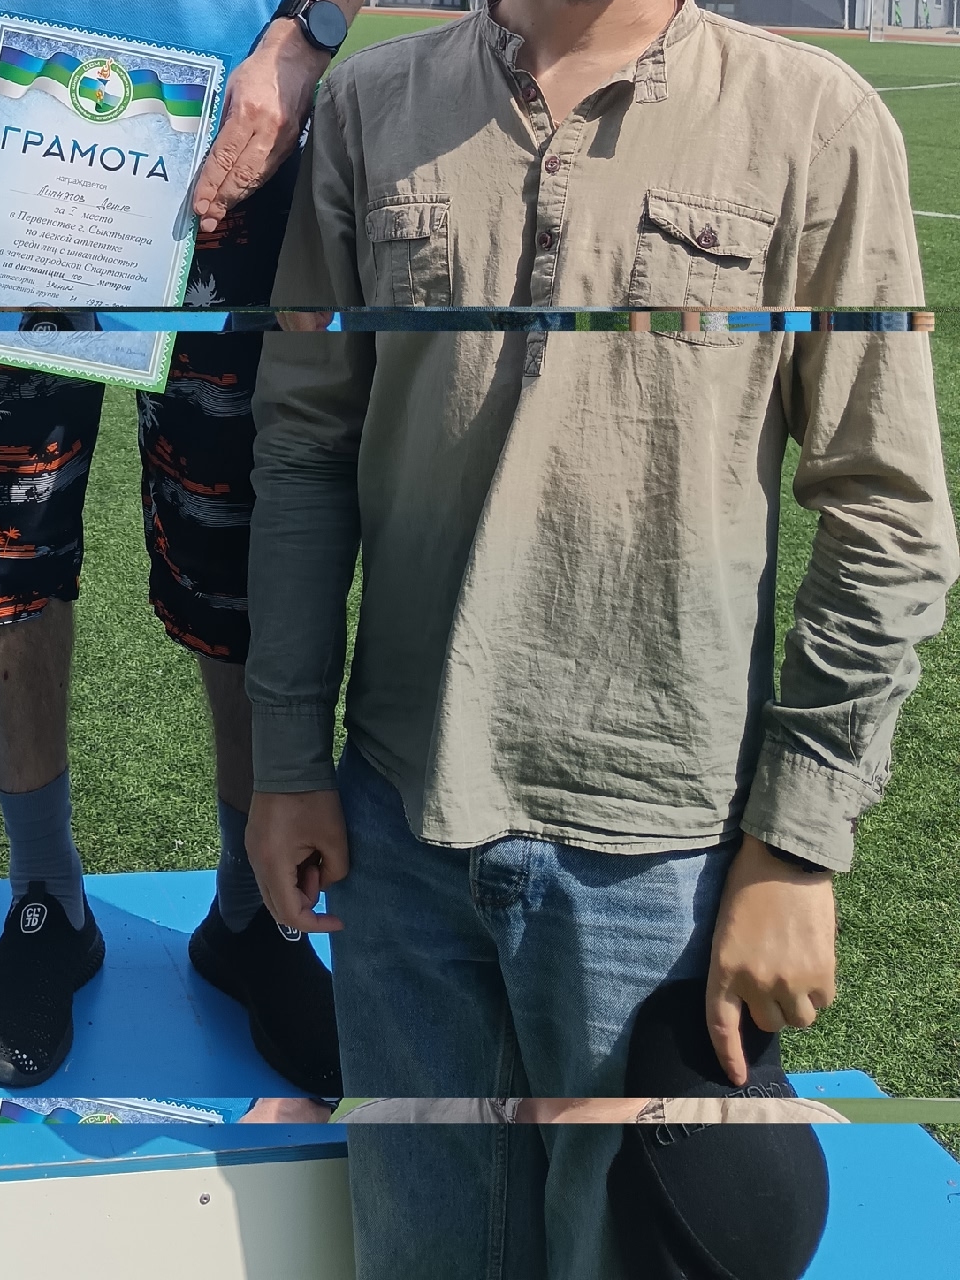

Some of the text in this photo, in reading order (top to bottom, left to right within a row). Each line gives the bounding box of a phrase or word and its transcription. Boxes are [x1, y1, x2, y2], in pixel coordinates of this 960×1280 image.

[0, 125, 169, 182] ГРАМОТА
[56, 176, 108, 191] награждается
[17, 210, 76, 231] Первенстве
[78, 224, 85, 233] г.
[88, 224, 153, 246] Сыктывкара
[53, 207, 66, 215] за
[81, 212, 114, 224] место
[13, 239, 139, 269] среди лиц с инвалидностью
[25, 228, 38, 237] по
[73, 238, 123, 253] атлетике
[0, 248, 5, 256] в
[34, 254, 82, 270] городской
[84, 262, 149, 283] Спартакиады
[3, 261, 13, 269] на
[14, 263, 66, 279] дистанции
[97, 280, 132, 292] метров
